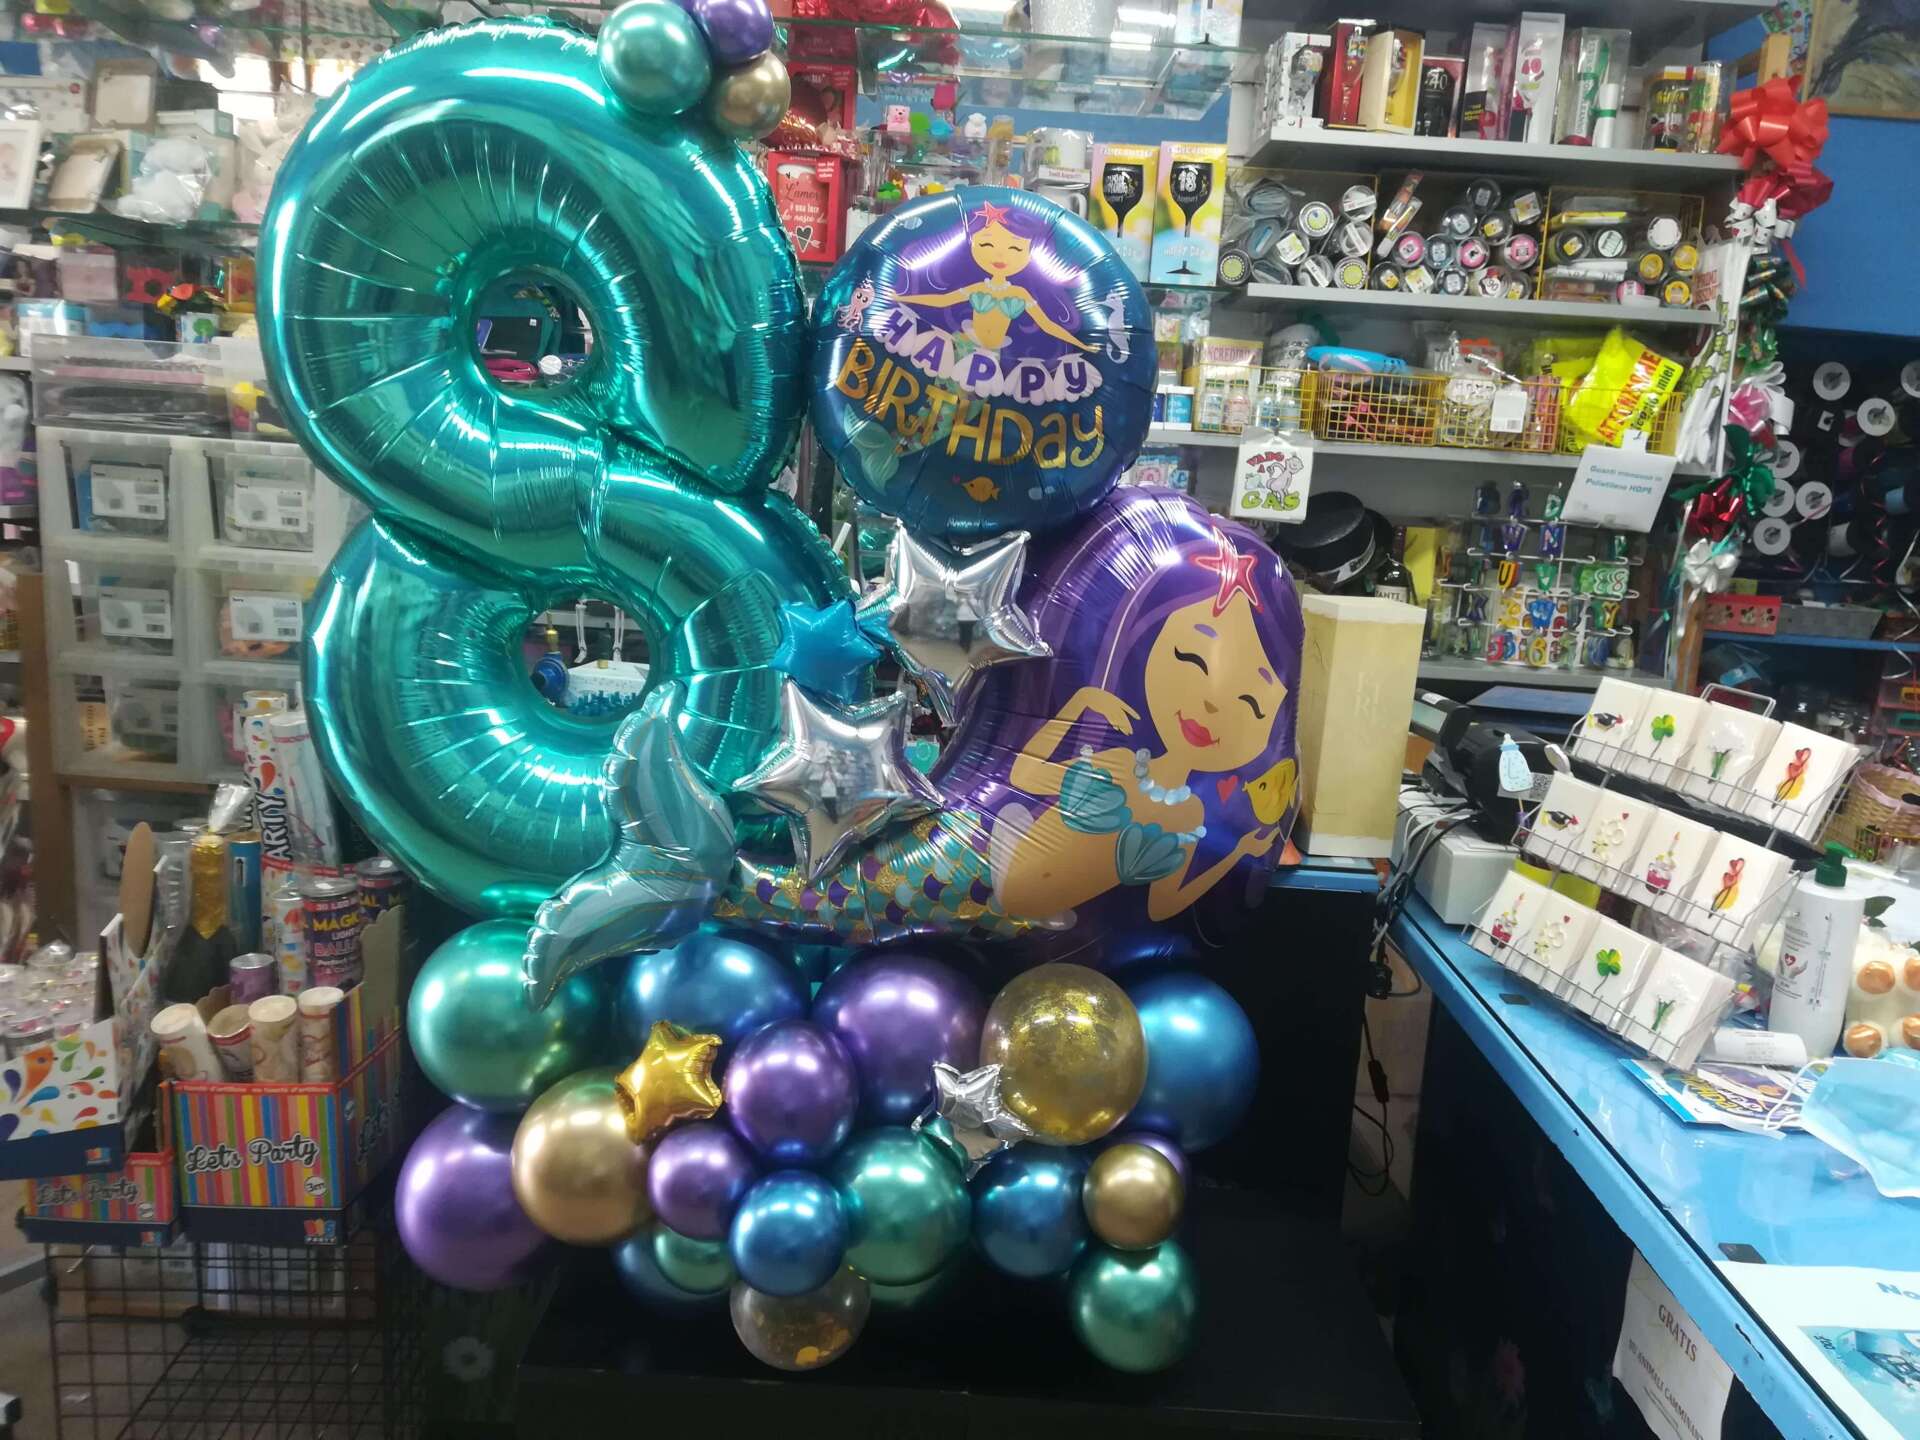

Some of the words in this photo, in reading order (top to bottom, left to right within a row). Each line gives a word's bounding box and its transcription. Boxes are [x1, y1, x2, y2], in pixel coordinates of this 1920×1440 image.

[1179, 168, 1198, 193] 18
[885, 308, 1089, 400] HAPPY
[1241, 490, 1301, 511] GAS
[256, 792, 293, 862] ARTY
[184, 1143, 243, 1174] Let's
[248, 1133, 320, 1167] Party
[1658, 1304, 1698, 1362] GRATIS
